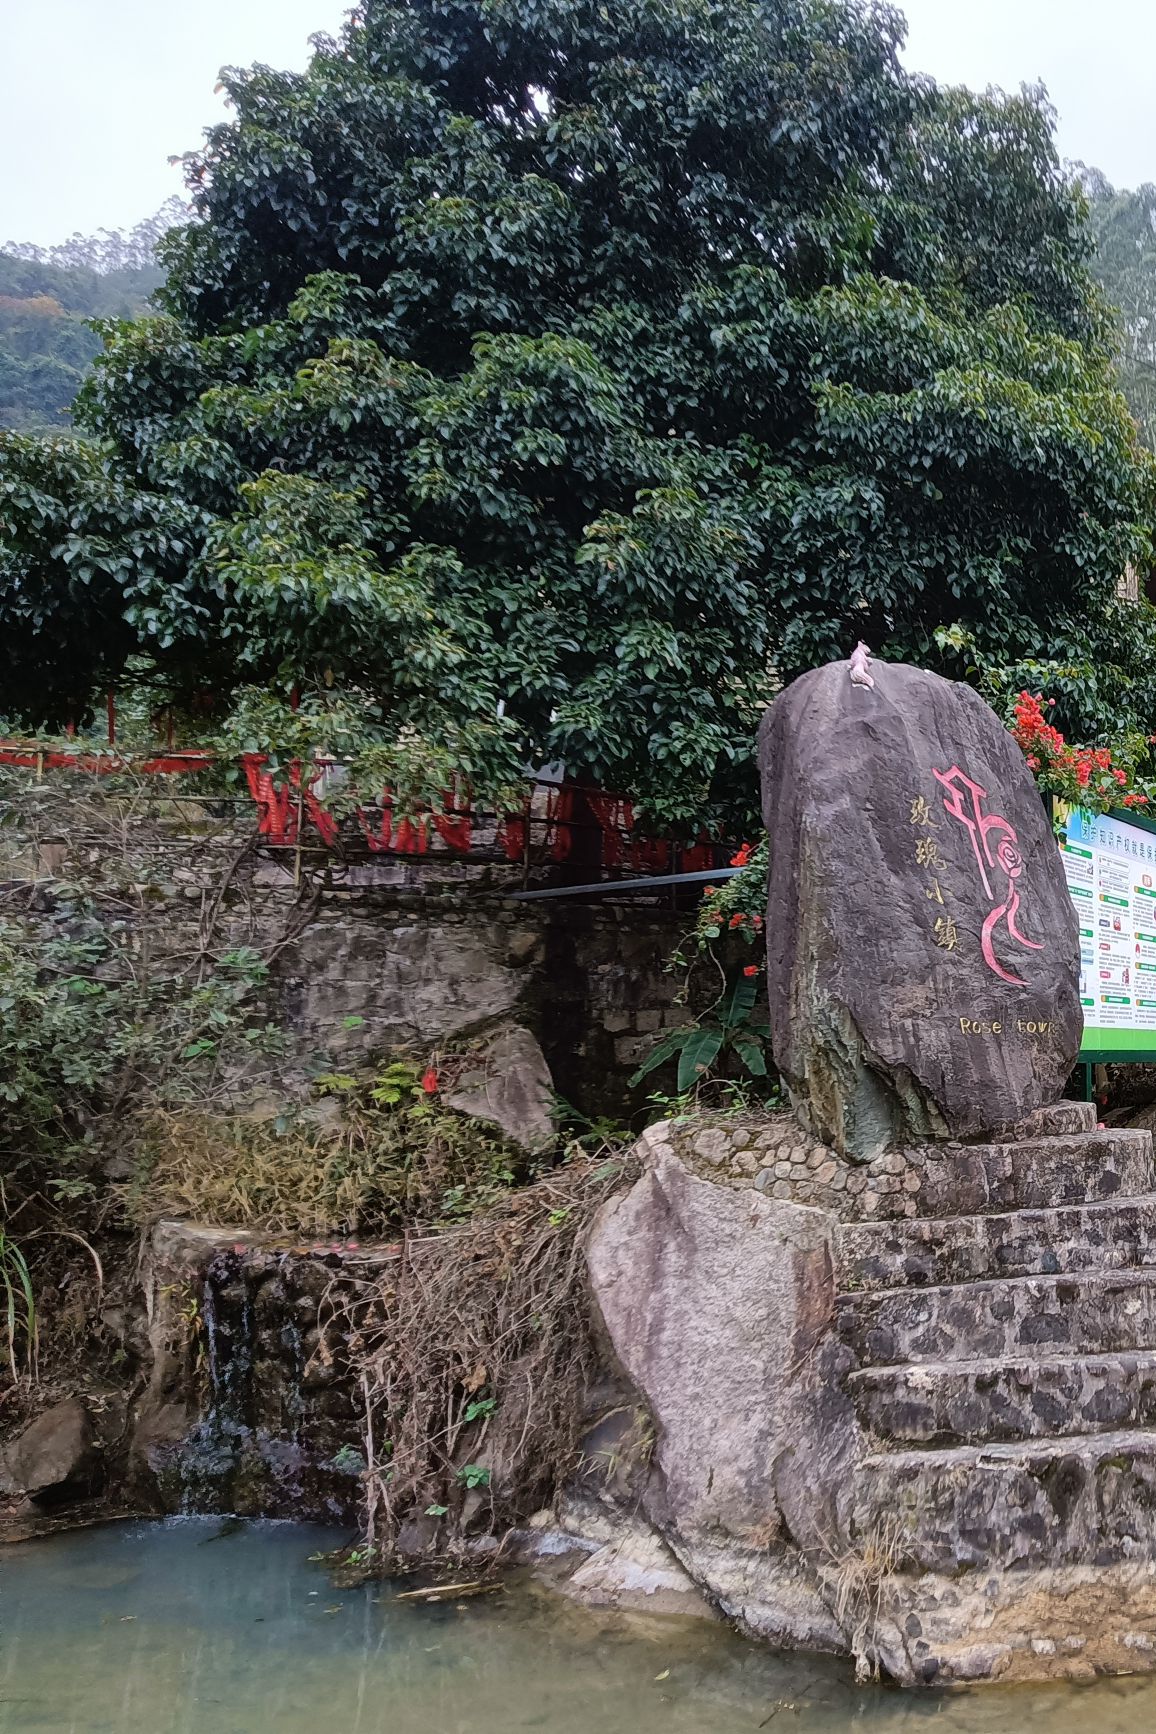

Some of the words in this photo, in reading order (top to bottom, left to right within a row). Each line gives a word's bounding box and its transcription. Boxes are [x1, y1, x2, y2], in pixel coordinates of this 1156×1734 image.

[909, 795, 963, 951] 玫瑰小镇
[960, 1017, 1002, 1034] Rose
